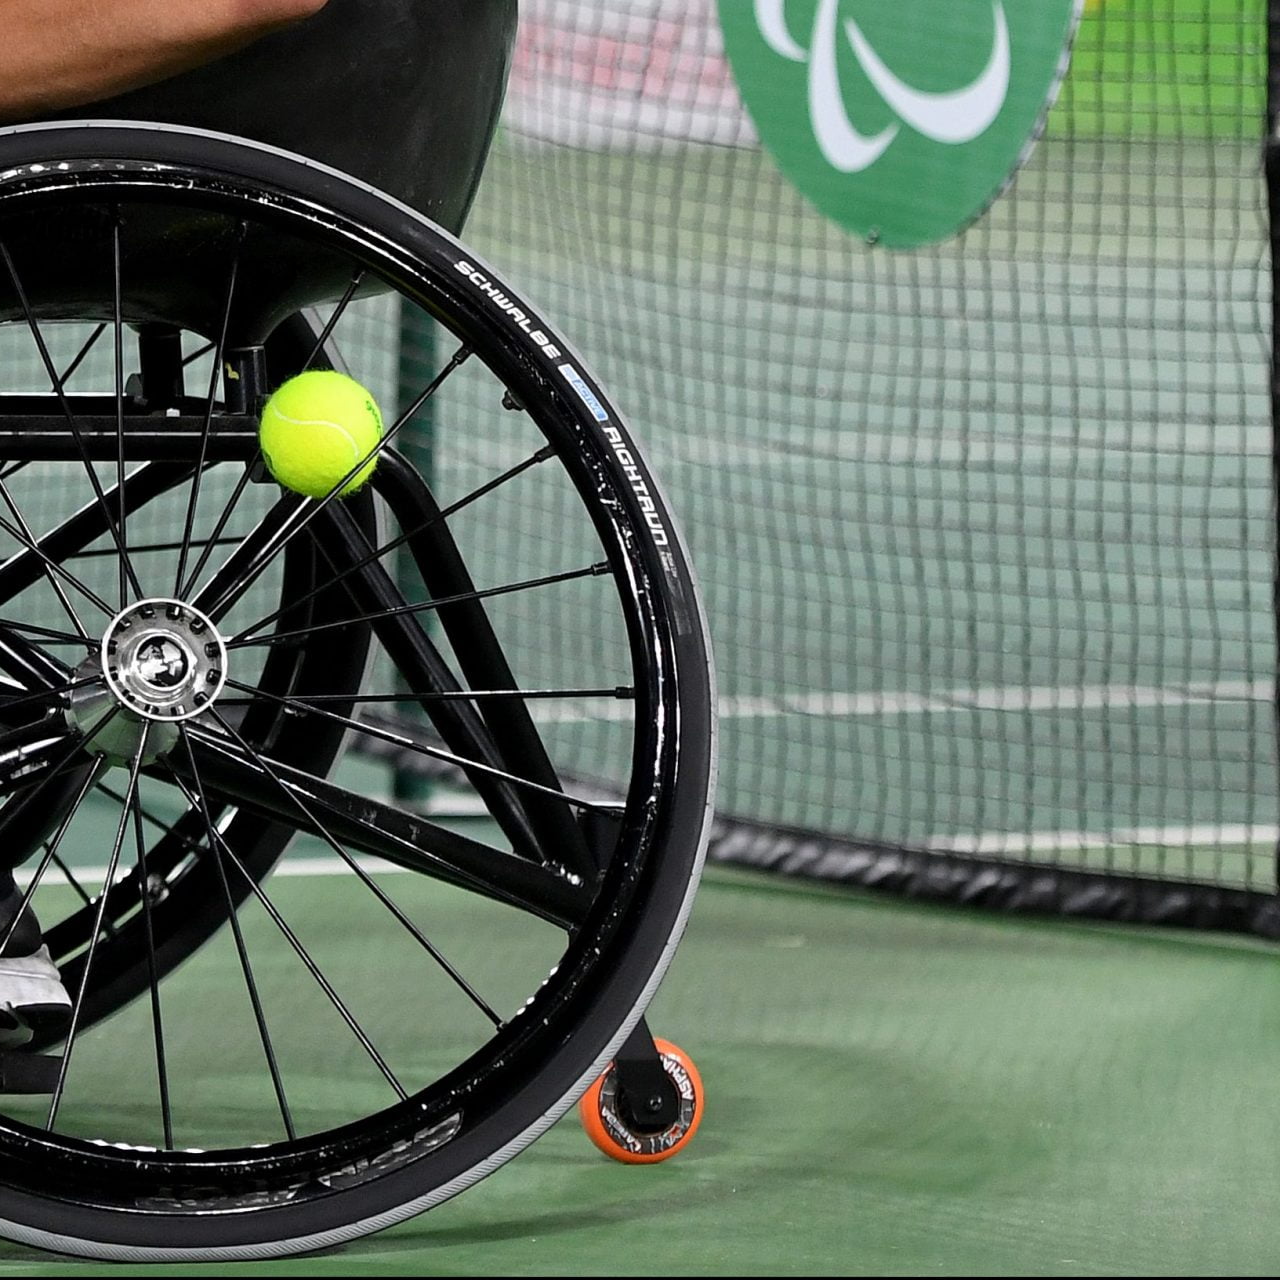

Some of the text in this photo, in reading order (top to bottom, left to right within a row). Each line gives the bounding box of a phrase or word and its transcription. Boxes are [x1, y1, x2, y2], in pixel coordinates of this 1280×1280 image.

[453, 260, 561, 360] SCHWALBE
[602, 426, 669, 546] RIGHTRUN
[659, 1054, 694, 1100] ASPHA
